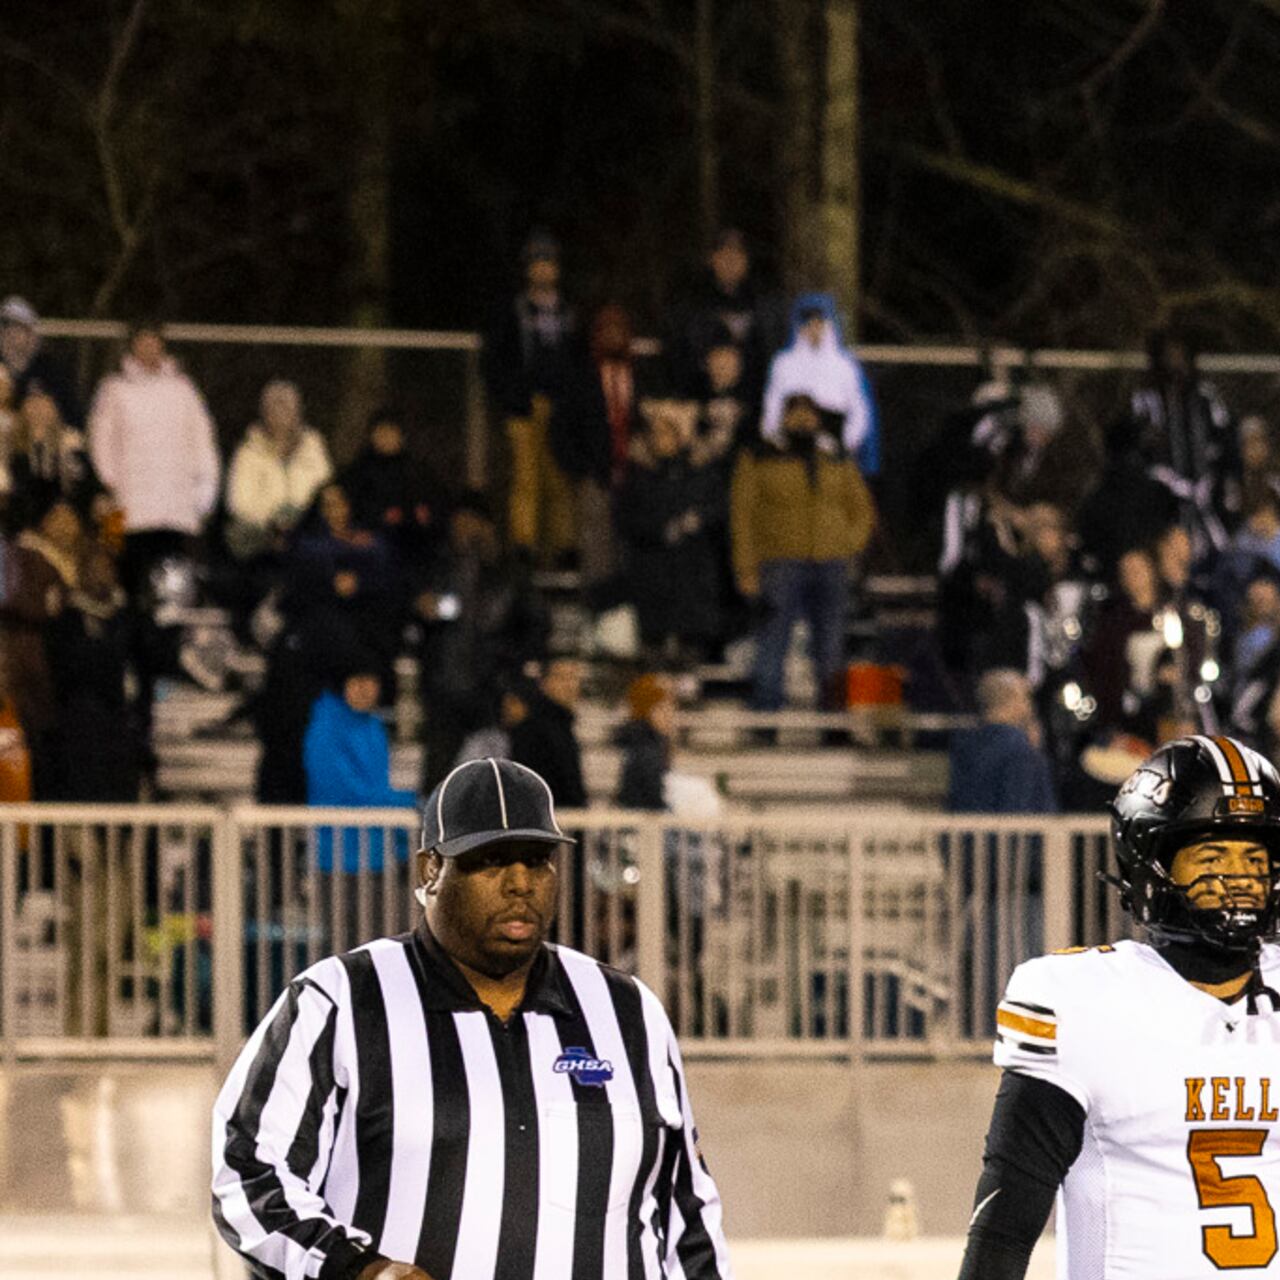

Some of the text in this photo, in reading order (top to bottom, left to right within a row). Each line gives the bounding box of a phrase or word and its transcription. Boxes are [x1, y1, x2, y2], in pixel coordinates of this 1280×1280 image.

[554, 1060, 612, 1072] GHSA
[1184, 1076, 1279, 1122] KELL
[1186, 1128, 1279, 1271] 5
